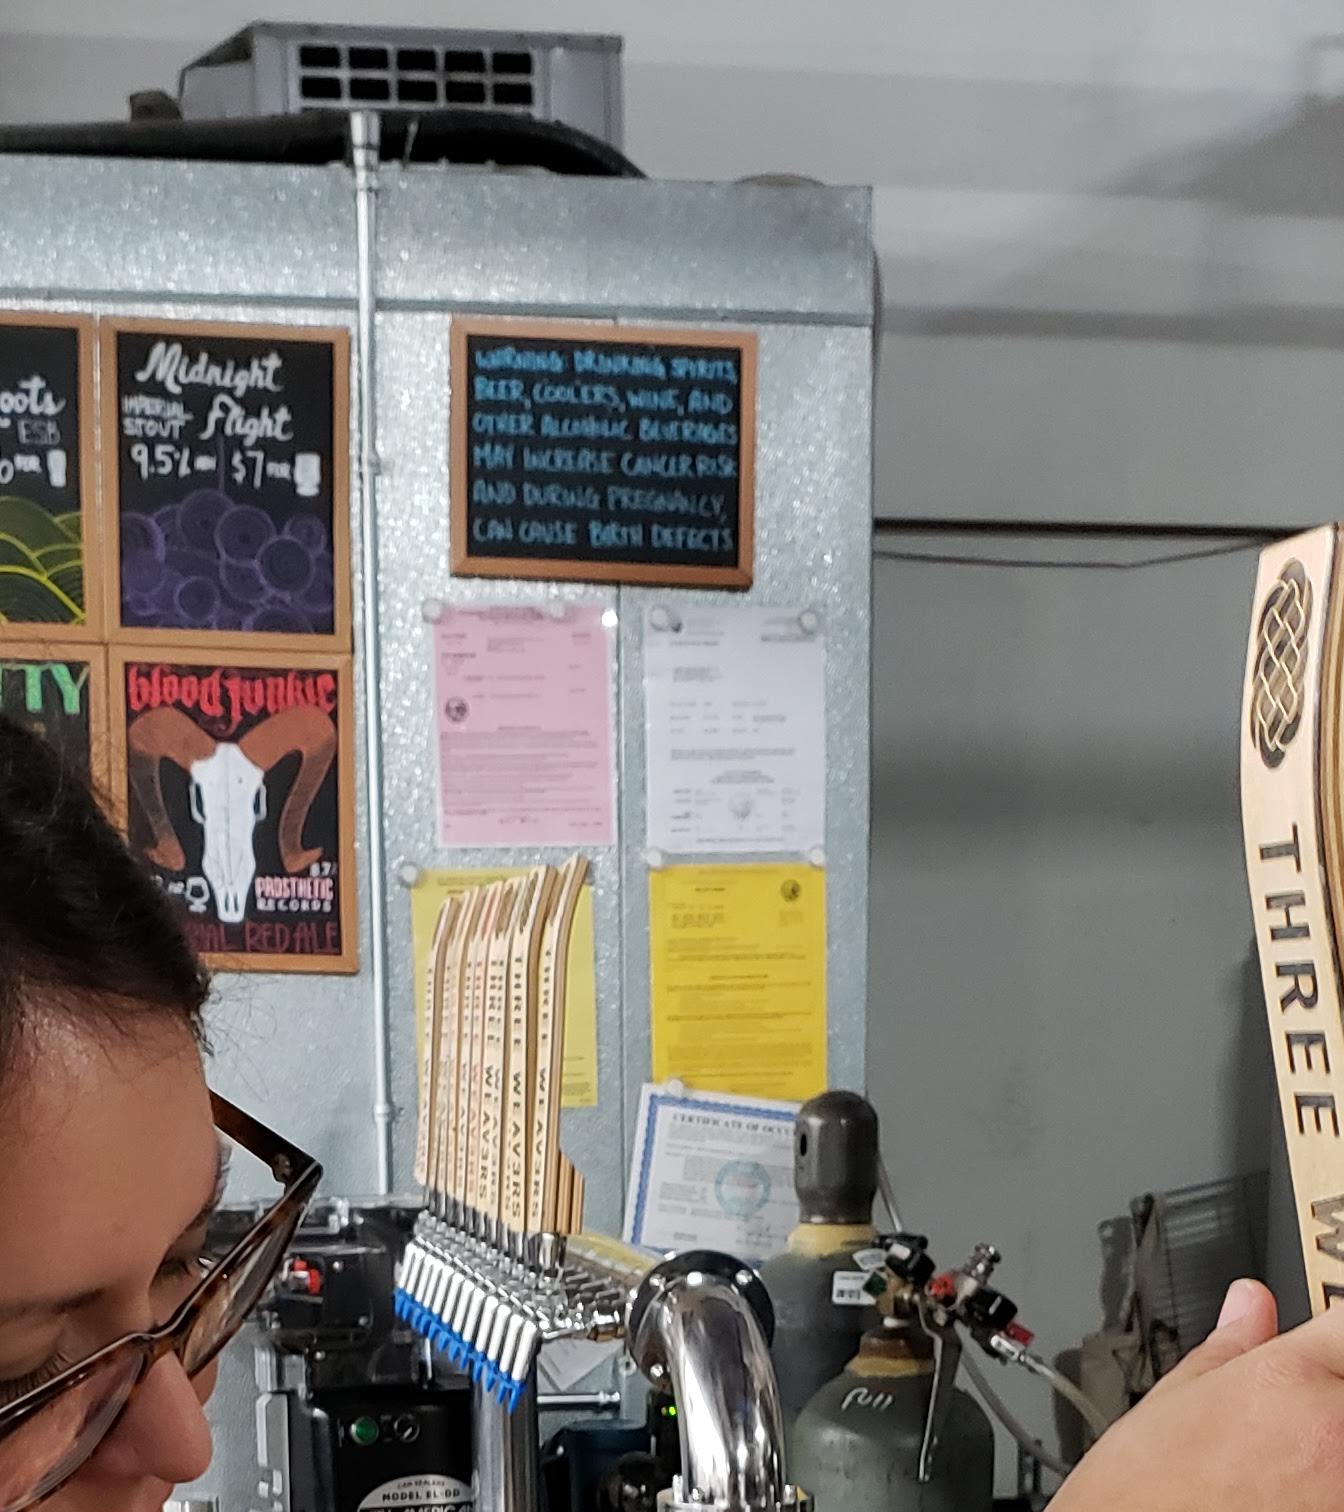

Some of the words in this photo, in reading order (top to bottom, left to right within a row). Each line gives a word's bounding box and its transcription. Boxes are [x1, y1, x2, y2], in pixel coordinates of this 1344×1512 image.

[134, 340, 284, 398] Midnight
[122, 416, 186, 440] STOUT
[199, 393, 295, 447] Flight
[472, 516, 514, 543] CAN
[518, 518, 577, 545] CAUSE
[129, 664, 223, 717] blood
[223, 670, 337, 734] junkie
[256, 876, 334, 901] PROSTHETIC
[256, 899, 332, 913] RECORDS
[245, 921, 292, 953] RED
[293, 921, 339, 954] ALE
[1258, 823, 1340, 1138] THREE
[672, 1113, 743, 1130] CERTIFICATE
[745, 1122, 761, 1132] OF
[382, 1490, 422, 1502] MODEL
